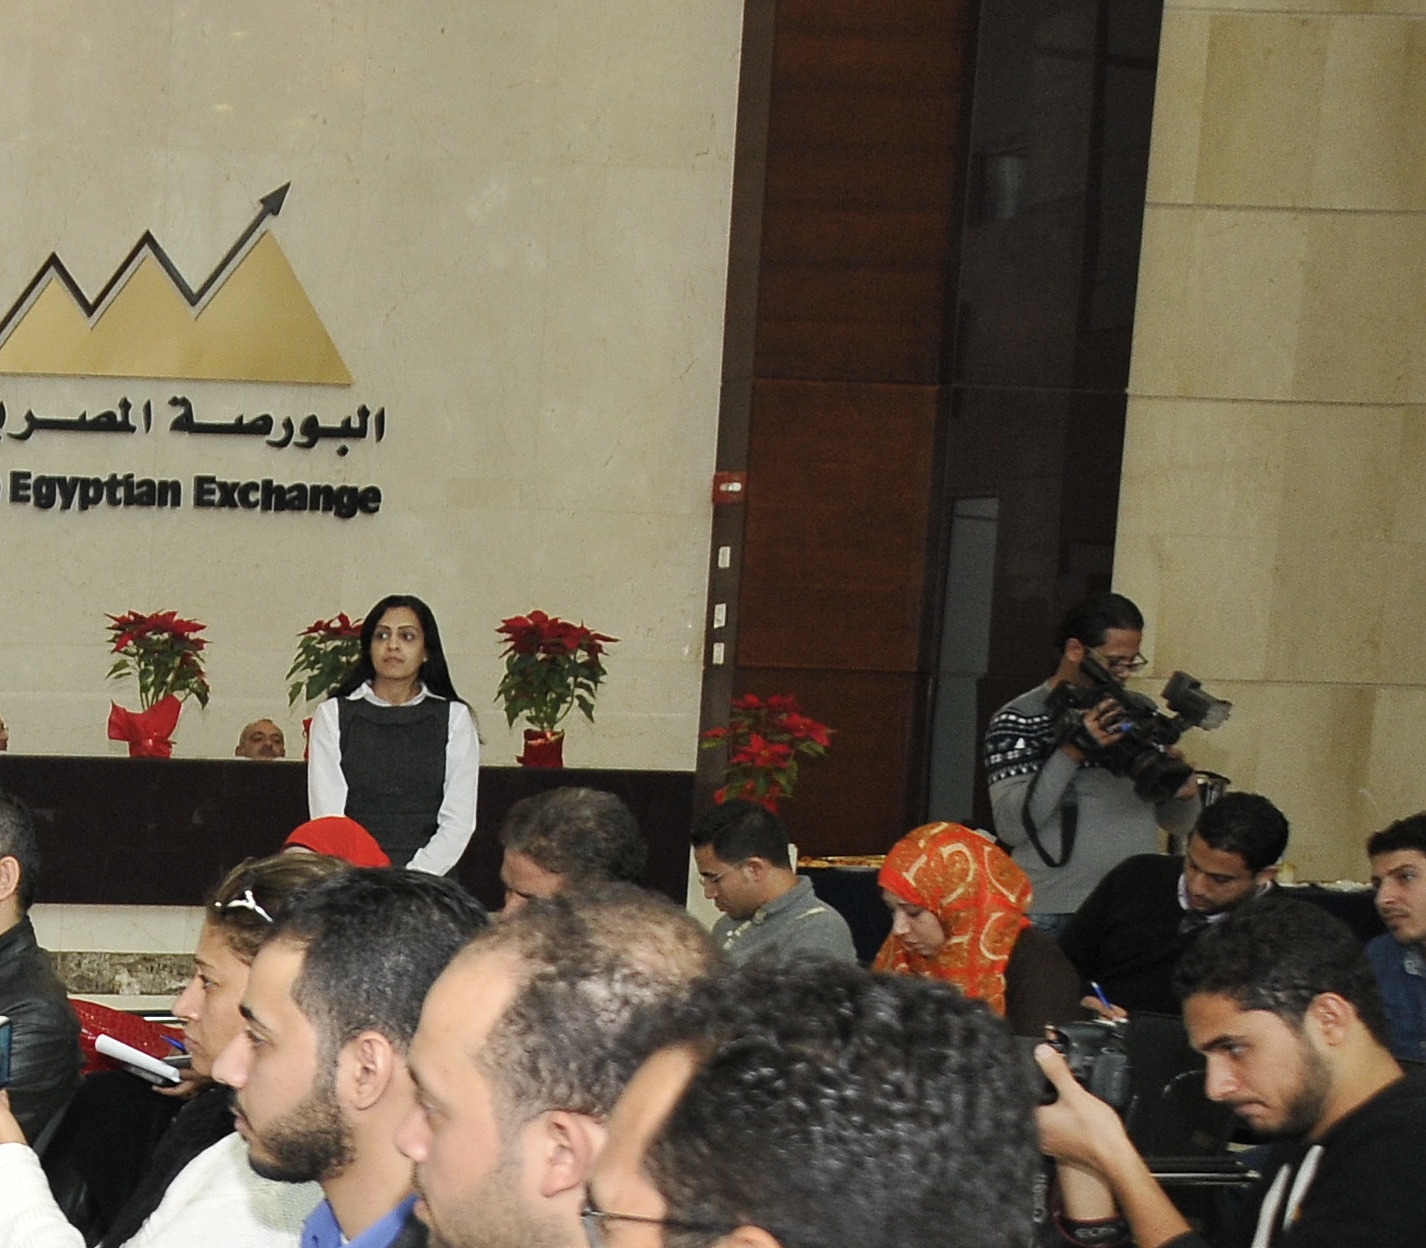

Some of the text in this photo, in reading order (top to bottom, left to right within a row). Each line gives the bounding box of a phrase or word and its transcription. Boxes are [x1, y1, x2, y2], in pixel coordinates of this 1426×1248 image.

[168, 395, 386, 457] البورصة
[8, 469, 182, 512] Egyptian
[193, 474, 384, 519] Exchange
